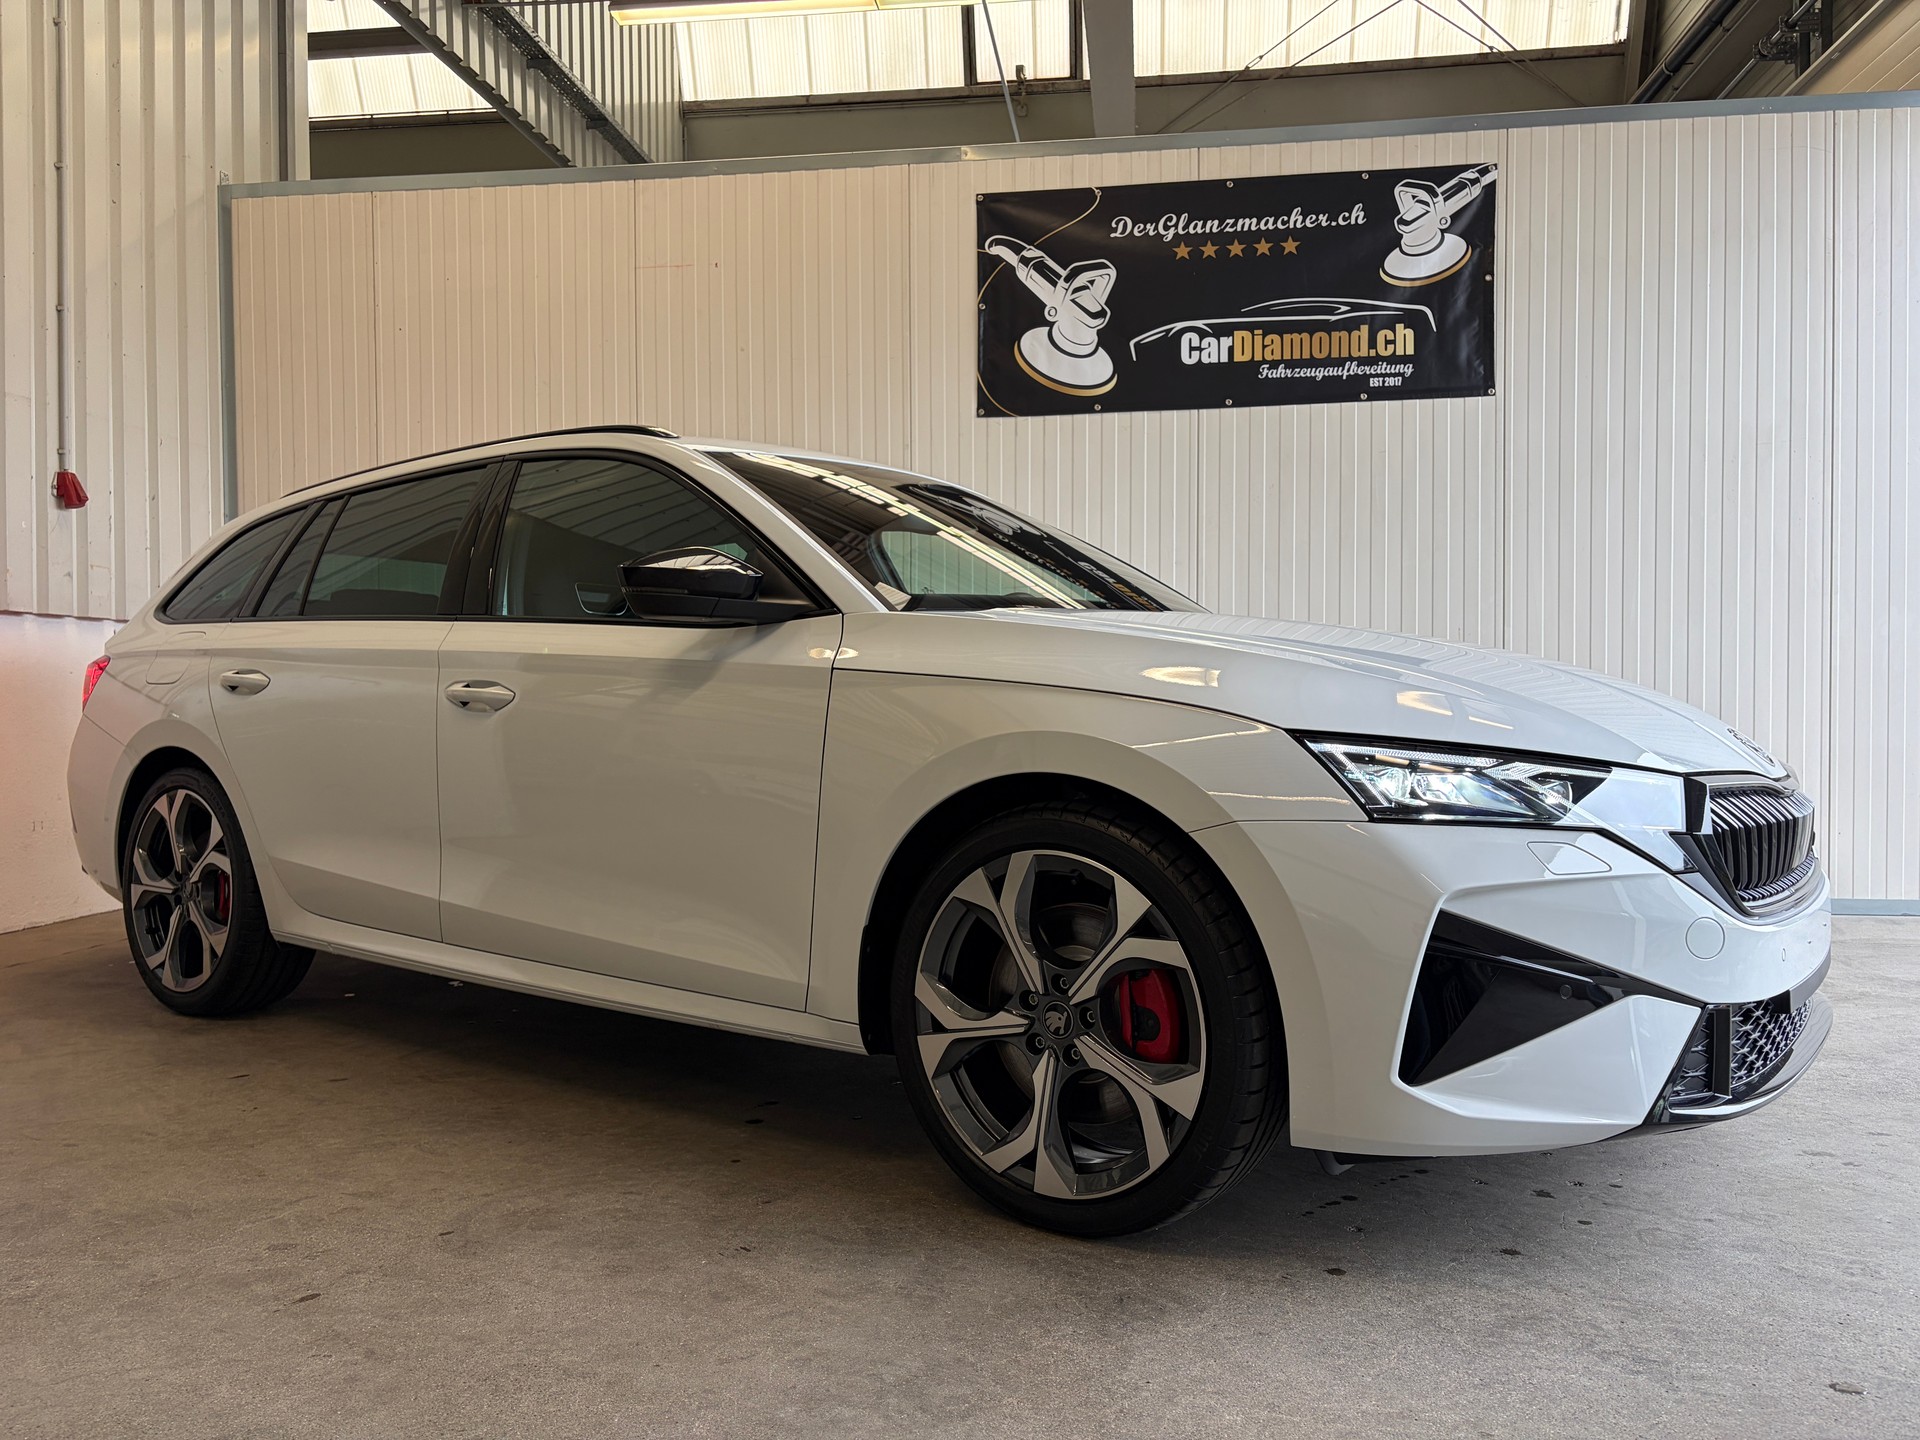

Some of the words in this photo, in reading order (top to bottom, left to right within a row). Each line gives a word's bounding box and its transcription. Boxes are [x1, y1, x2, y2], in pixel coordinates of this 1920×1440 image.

[1110, 203, 1367, 242] DerGlanzmacher.ch
[1180, 323, 1415, 365] CarDiamond.ch
[1258, 361, 1414, 381] Fahrzeugaufbereitung
[1369, 377, 1383, 387] EST
[1384, 376, 1403, 387] 2017
